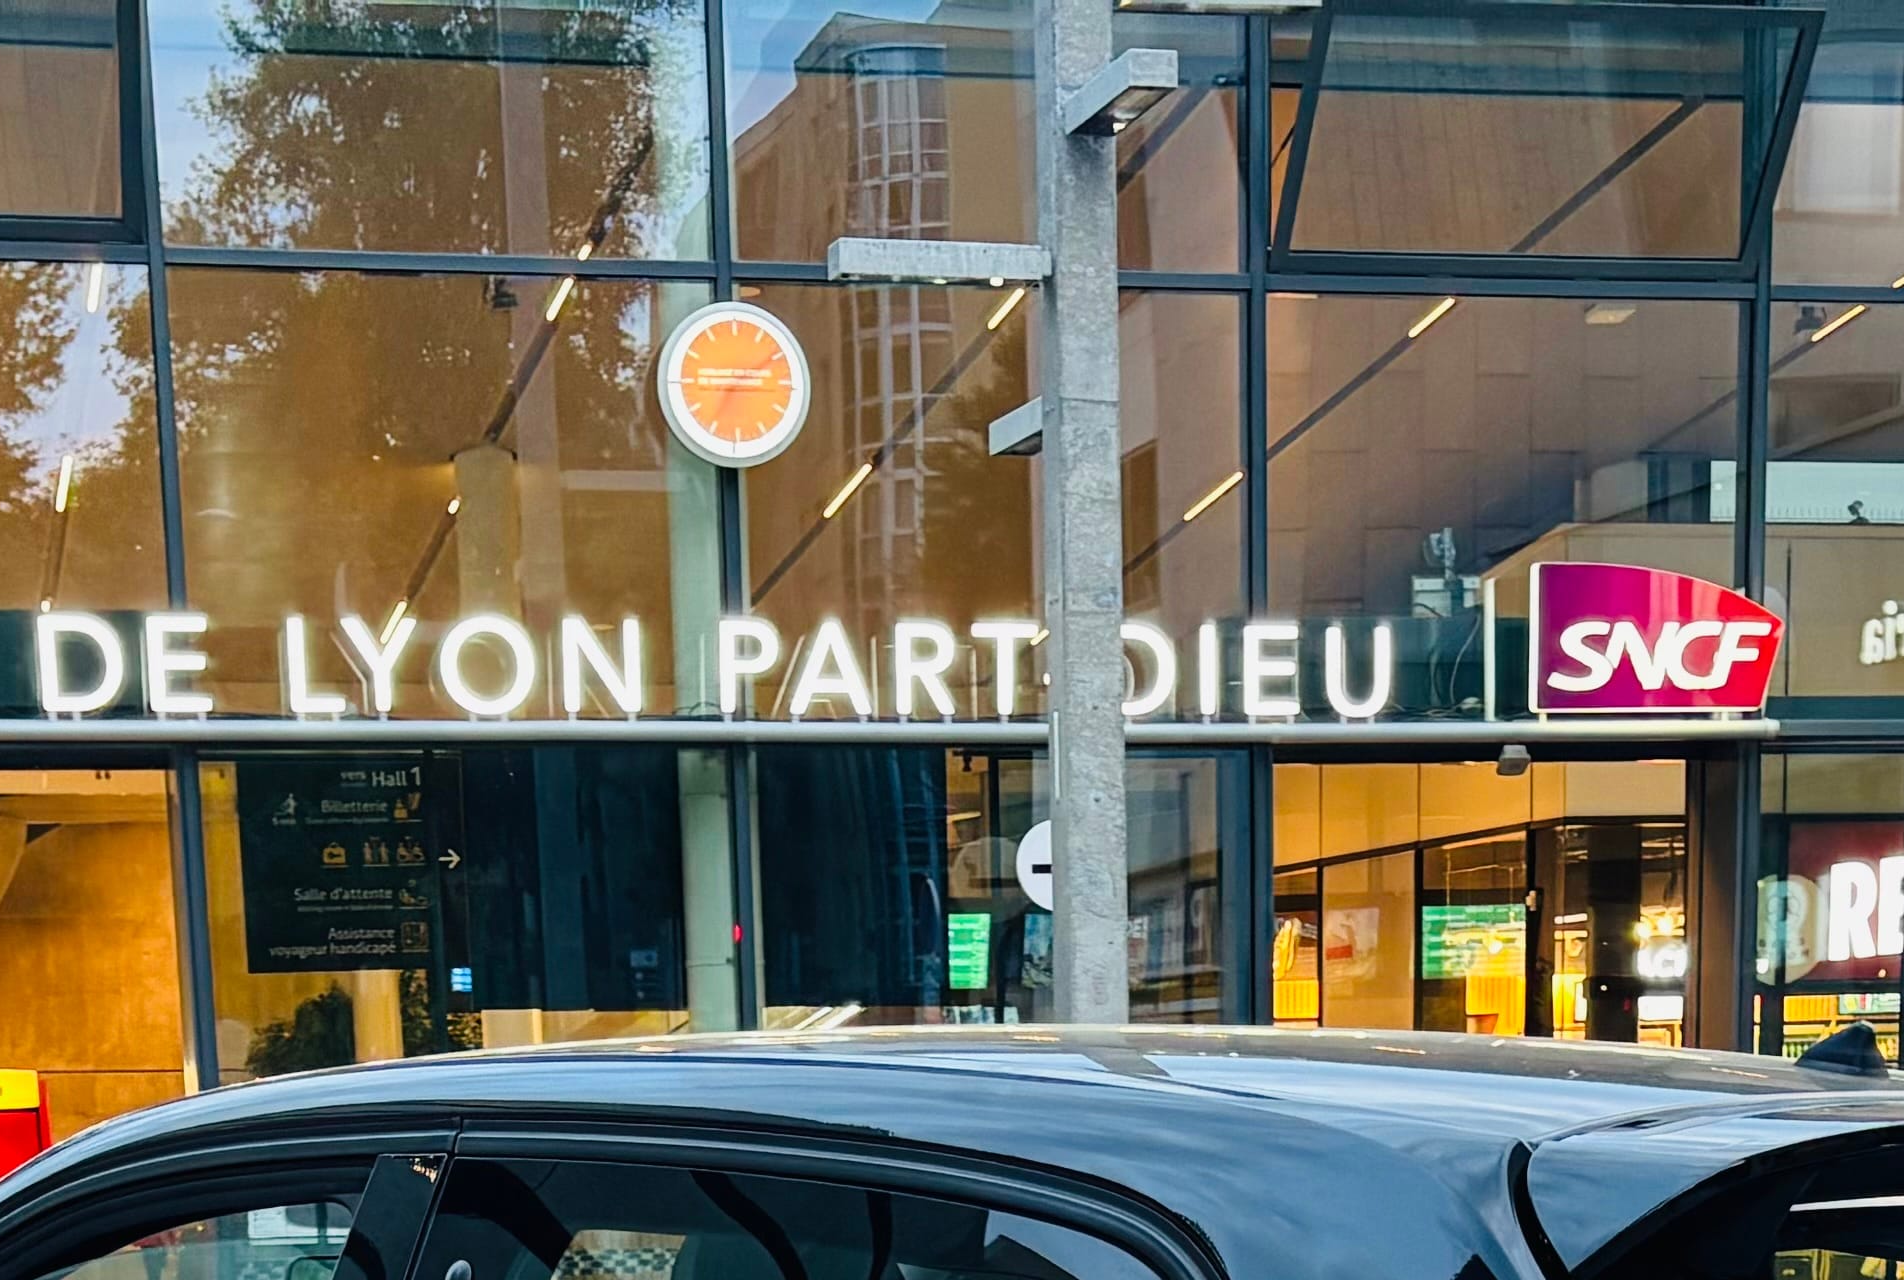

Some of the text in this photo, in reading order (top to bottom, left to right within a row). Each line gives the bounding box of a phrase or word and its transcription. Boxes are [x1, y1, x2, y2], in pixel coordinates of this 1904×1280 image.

[1545, 619, 1772, 692] SNCF
[38, 615, 212, 712] DE
[287, 616, 641, 714] LYON
[719, 620, 1390, 717] PARTDIEU
[371, 769, 407, 787] Hall
[410, 766, 421, 786] 1
[320, 799, 390, 814] Billetterie
[294, 887, 393, 901] Salle d'attente
[327, 927, 396, 940] Assistance
[269, 940, 397, 959] voyageur handicapé
